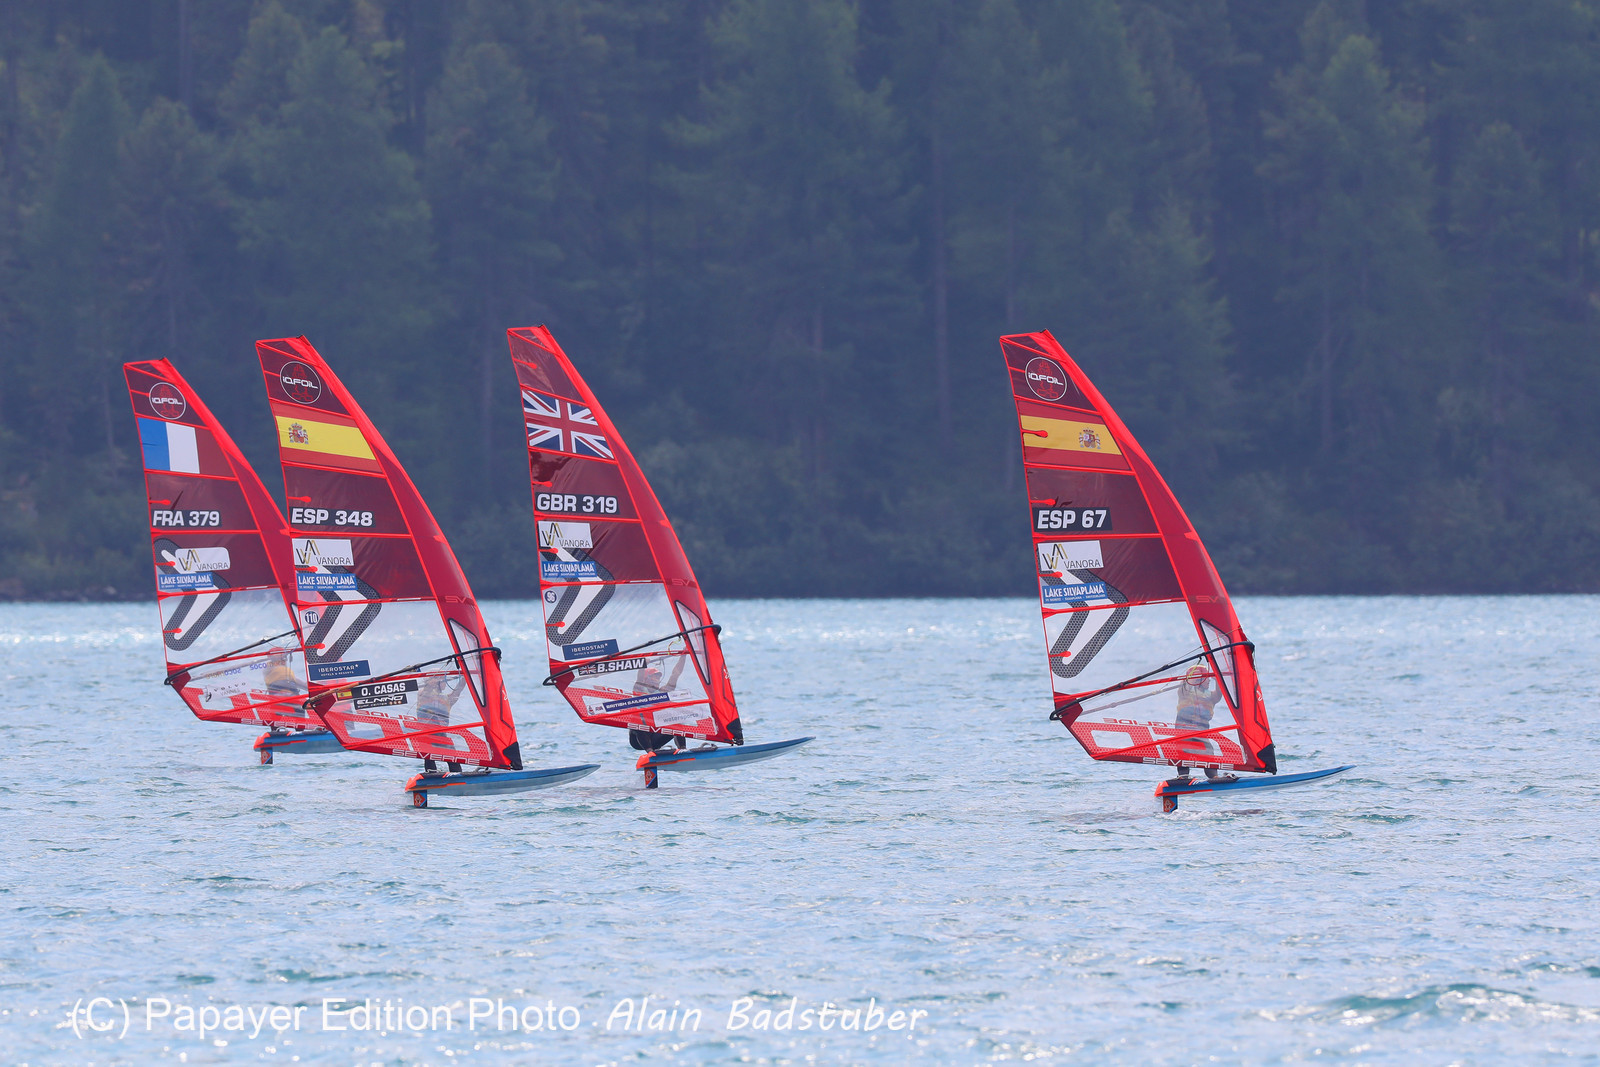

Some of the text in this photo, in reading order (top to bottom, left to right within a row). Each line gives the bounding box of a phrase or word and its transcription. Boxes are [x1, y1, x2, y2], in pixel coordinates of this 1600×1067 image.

[536, 493, 617, 513] GBR 319
[152, 510, 219, 526] FRA 379
[291, 508, 373, 527] ESP 348
[1037, 509, 1107, 529] ESP 67
[559, 539, 591, 548] VANORA
[196, 562, 229, 571] VANORA
[316, 556, 352, 565] VANORA
[543, 562, 595, 573] LAKE SILVAPLANA
[1064, 559, 1101, 569] VANORA
[160, 574, 212, 585] LAKE SILVAPLANA
[298, 575, 355, 585] LAKE SILVAPLANA
[1044, 587, 1062, 598] LAKE
[1063, 583, 1105, 597] SILVAPLANA
[361, 682, 406, 697] O. CASAS
[606, 700, 627, 709] BRITISH
[627, 722, 707, 740] SEVERNE
[391, 748, 481, 766] SEVERNE
[1142, 757, 1234, 771] SEVERNE
